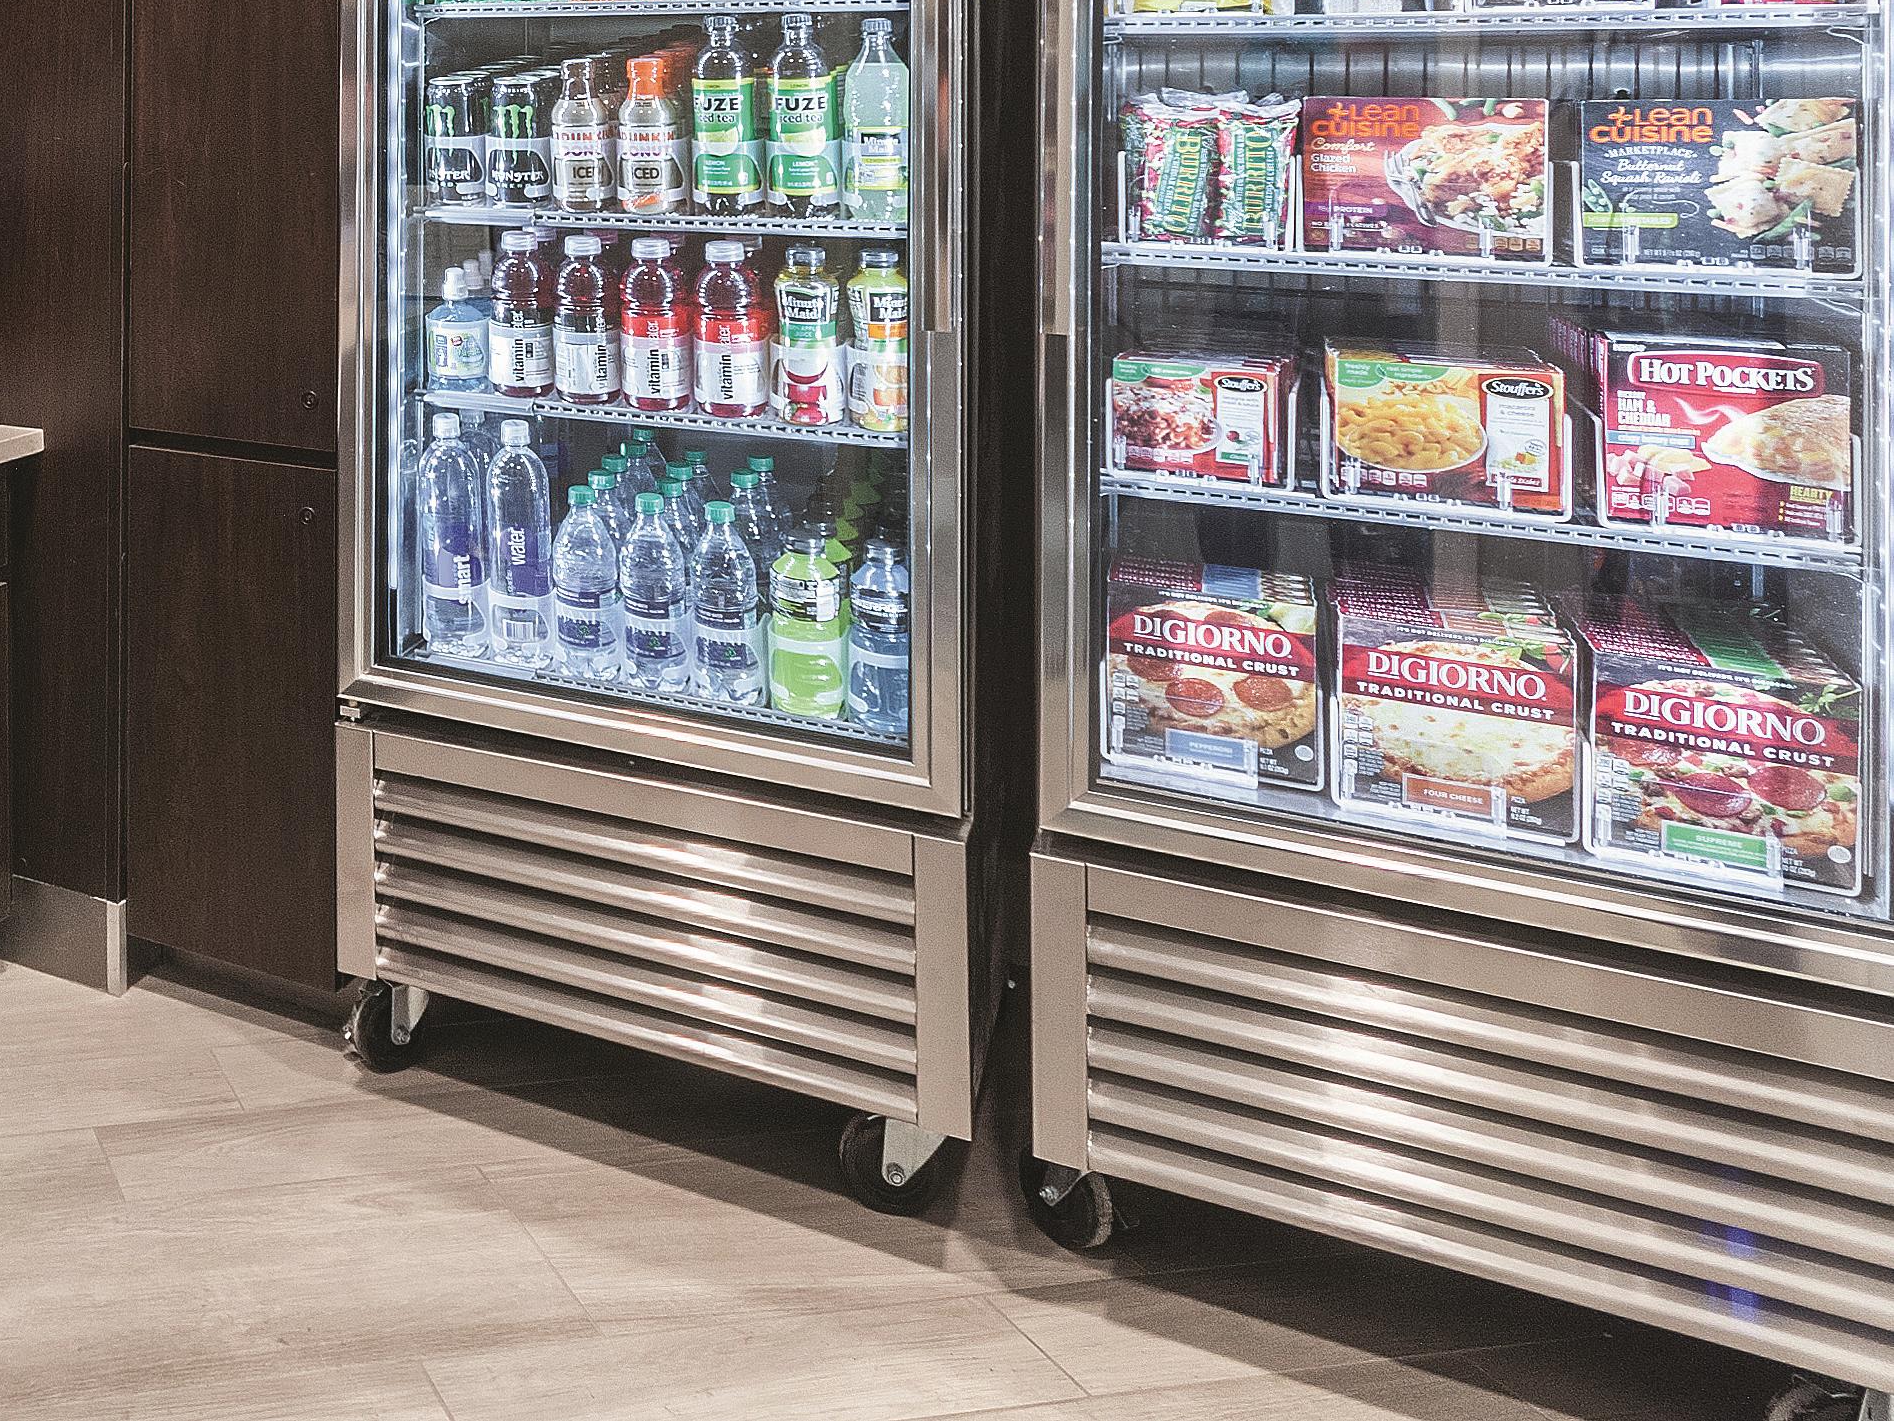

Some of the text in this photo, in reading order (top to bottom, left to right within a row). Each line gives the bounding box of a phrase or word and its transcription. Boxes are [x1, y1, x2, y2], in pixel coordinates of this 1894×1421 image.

[693, 96, 740, 113] FUZE
[774, 95, 827, 112] FUZE
[716, 114, 736, 123] tea
[778, 112, 824, 123] iced tea
[1310, 137, 1377, 153] Comfort
[1607, 145, 1695, 158] MARKETPLACE
[1310, 153, 1351, 165] Glazed
[1617, 158, 1686, 172] Butternut
[1310, 162, 1357, 174] Chicken
[1165, 134, 1202, 233] BURRITO
[1242, 128, 1273, 232] BURRITO
[1600, 170, 1702, 186] Squash Ravioli
[1333, 205, 1373, 215] PROTEIN
[647, 348, 661, 395] vitamin
[719, 353, 733, 401] vitamin
[1638, 358, 1816, 392] HOT POCKETS
[1220, 377, 1262, 392] Stouffer's
[1490, 380, 1547, 397] Stouffer's
[1617, 399, 1657, 412] HAM &
[1617, 412, 1671, 427] CHEDDAR
[510, 527, 526, 566] water
[1123, 641, 1300, 677] TRADITIONAL CRUST
[1356, 680, 1555, 721] TRADITIONAL CRUST
[1610, 721, 1835, 768] TRADITIONAL CRUST
[1423, 788, 1484, 805] FOUR CHEESE
[1695, 834, 1743, 849] SUPREME
